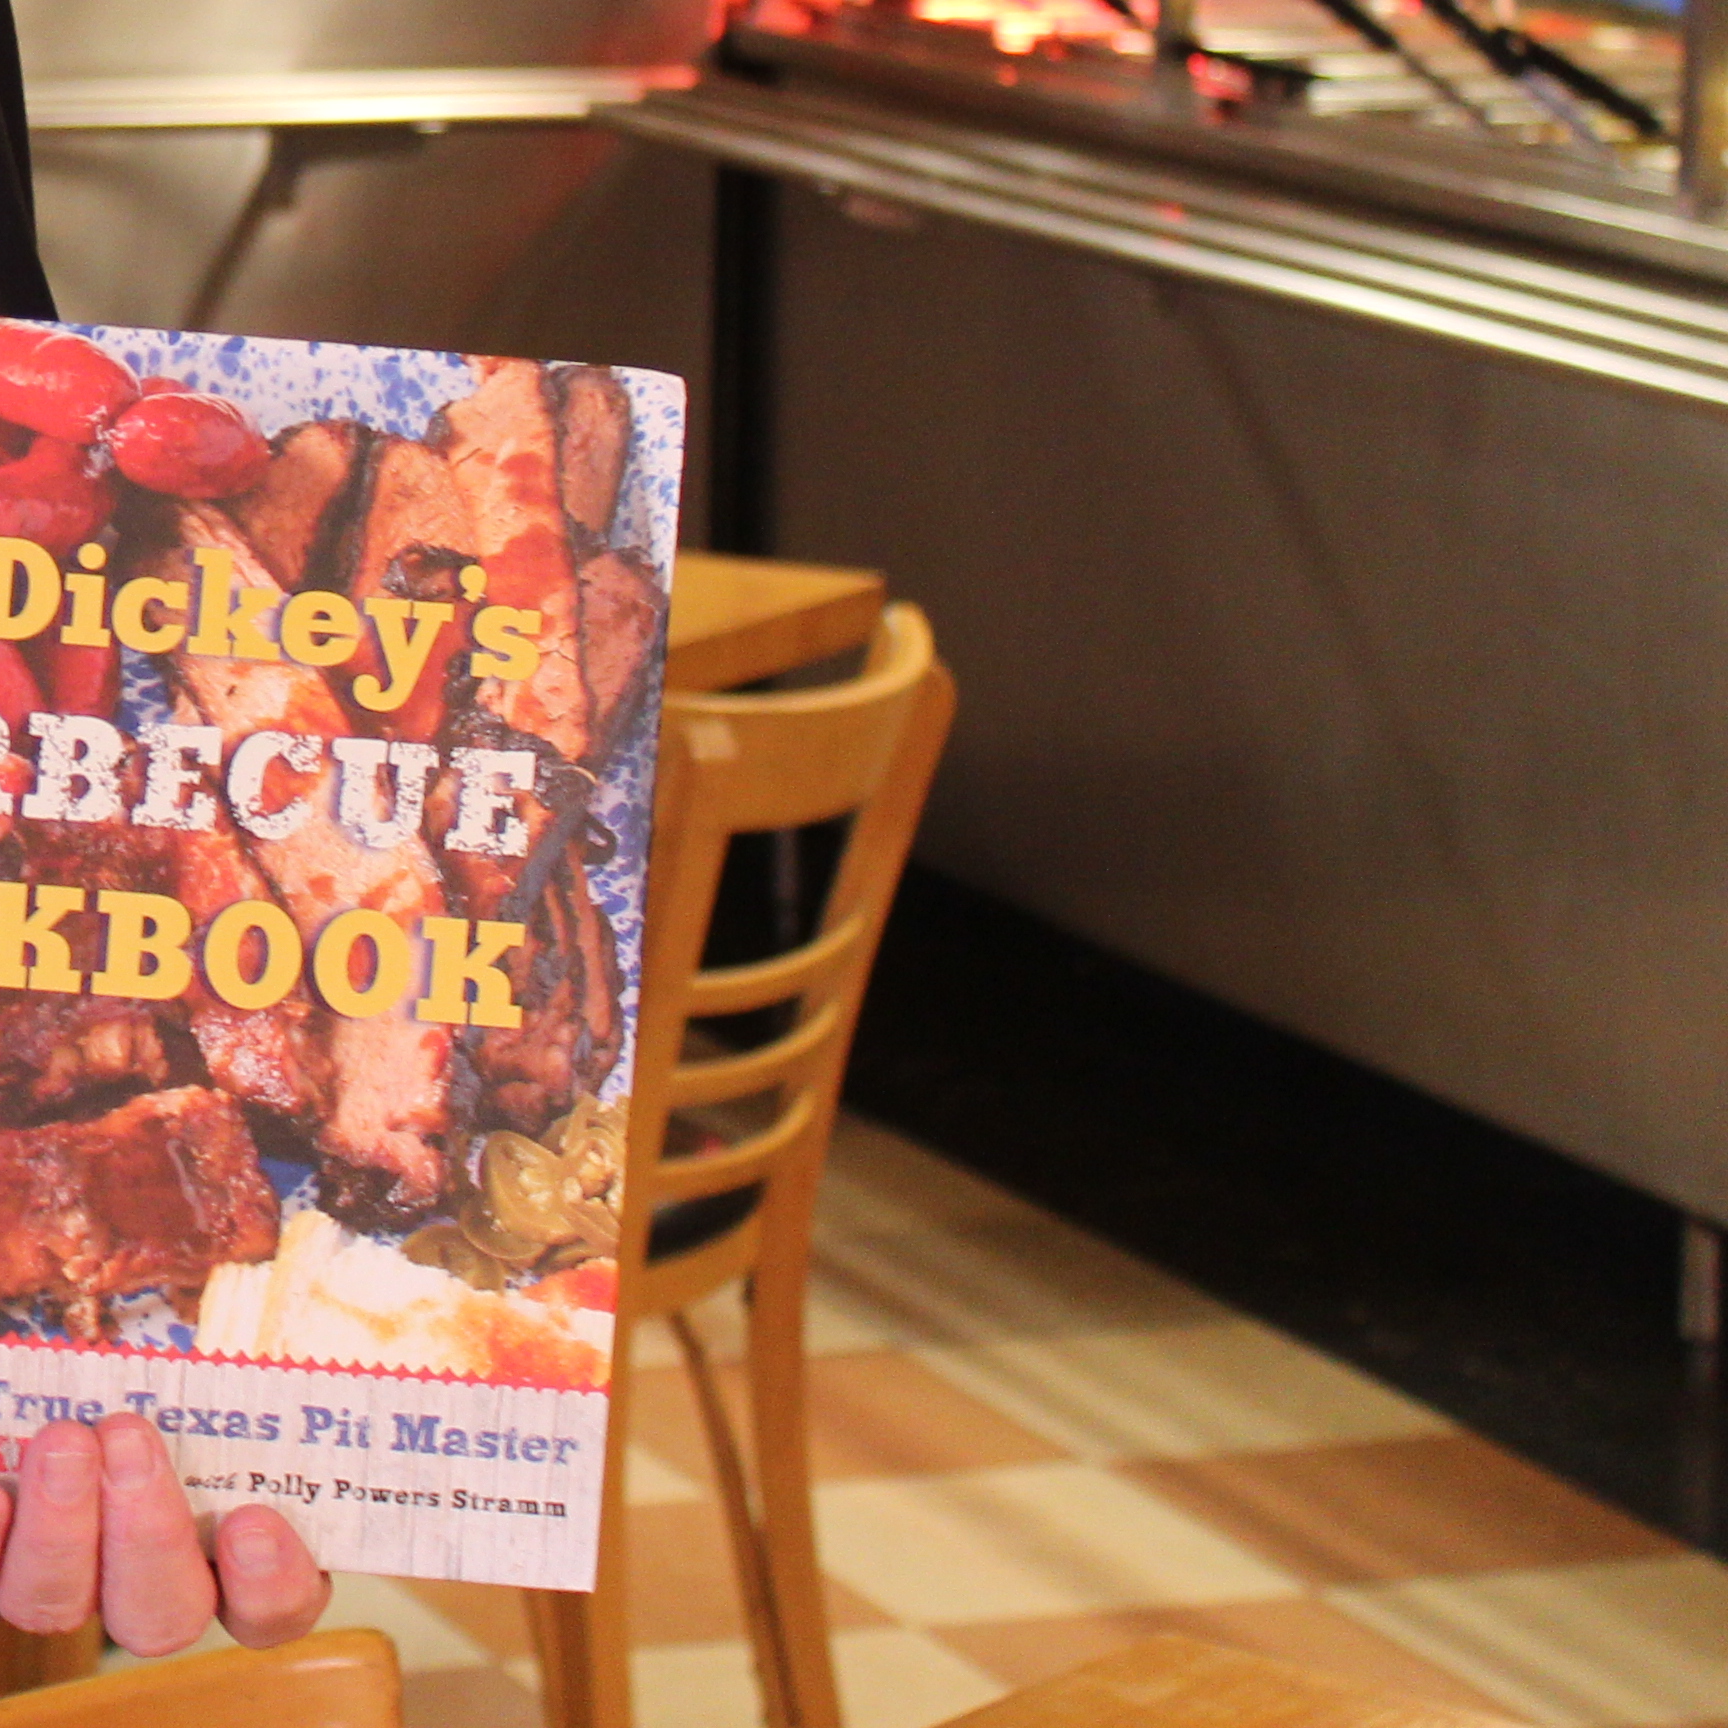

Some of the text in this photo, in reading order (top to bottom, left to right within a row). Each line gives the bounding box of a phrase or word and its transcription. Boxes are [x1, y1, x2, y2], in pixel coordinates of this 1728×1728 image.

[125, 1391, 280, 1441] Texas
[300, 1406, 372, 1449] Pit
[389, 1412, 580, 1466] Master
[247, 1472, 320, 1504] Polly
[332, 1478, 442, 1509] Powers
[451, 1489, 568, 1518] Stramm
